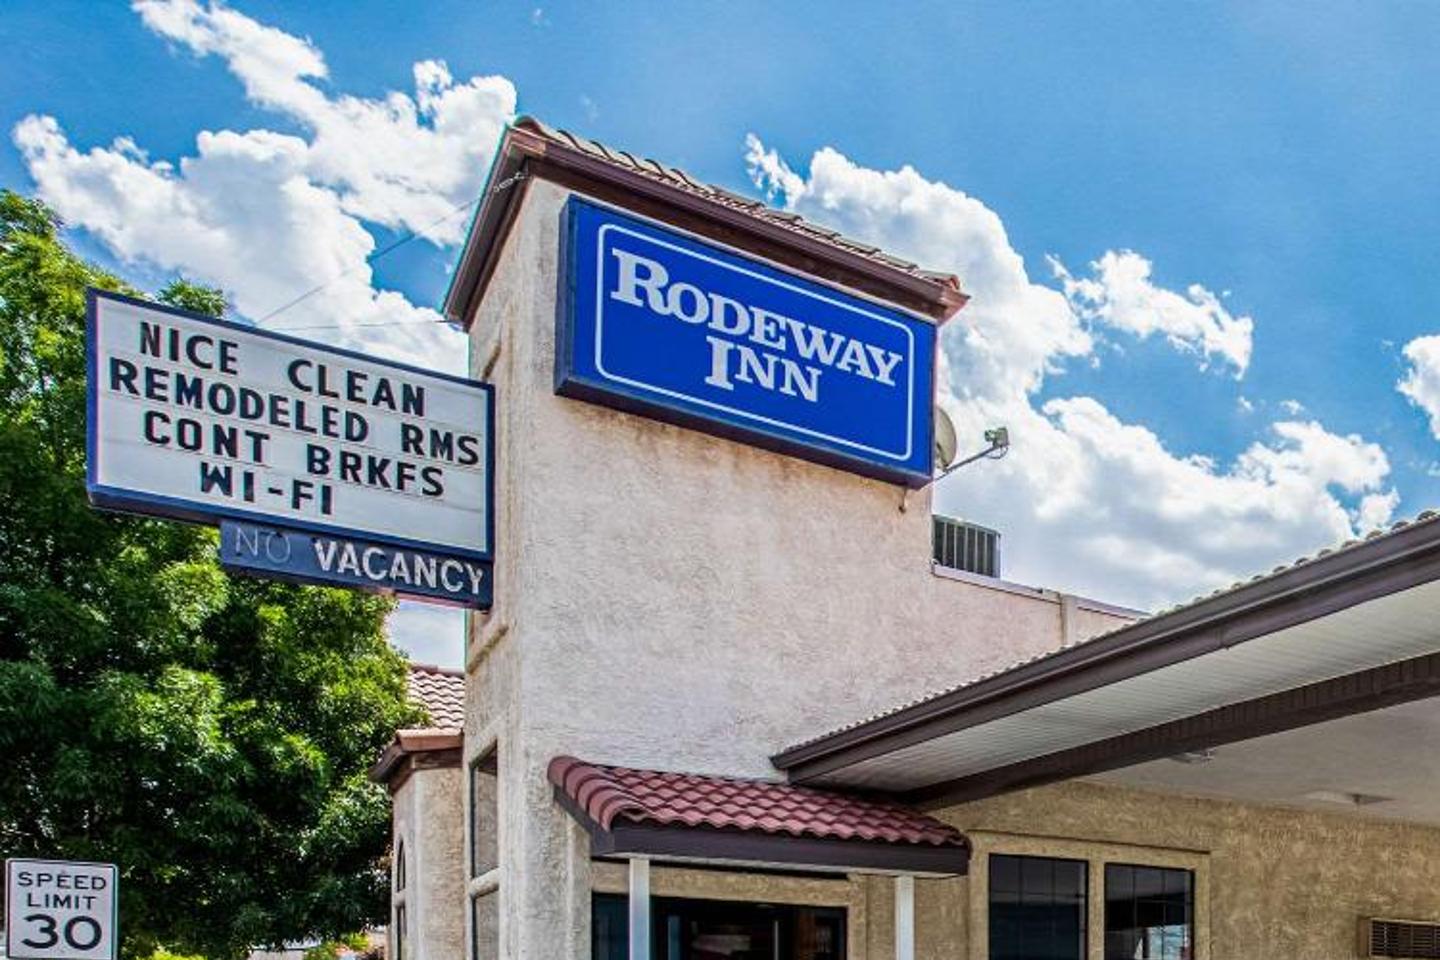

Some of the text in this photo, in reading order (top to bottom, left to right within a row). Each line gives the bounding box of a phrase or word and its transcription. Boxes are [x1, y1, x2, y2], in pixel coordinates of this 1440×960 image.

[610, 248, 902, 387] RODEWAY
[140, 321, 425, 417] NICE CLEAN
[705, 335, 822, 402] INN
[110, 357, 479, 466] REMODELED RMS
[144, 411, 444, 496] CONT BRKFS
[200, 461, 332, 515] WI-FI
[234, 524, 484, 595] NO VACANCY
[18, 871, 106, 890] SPEED
[27, 893, 97, 910] LIMIT
[21, 914, 102, 951] 30
